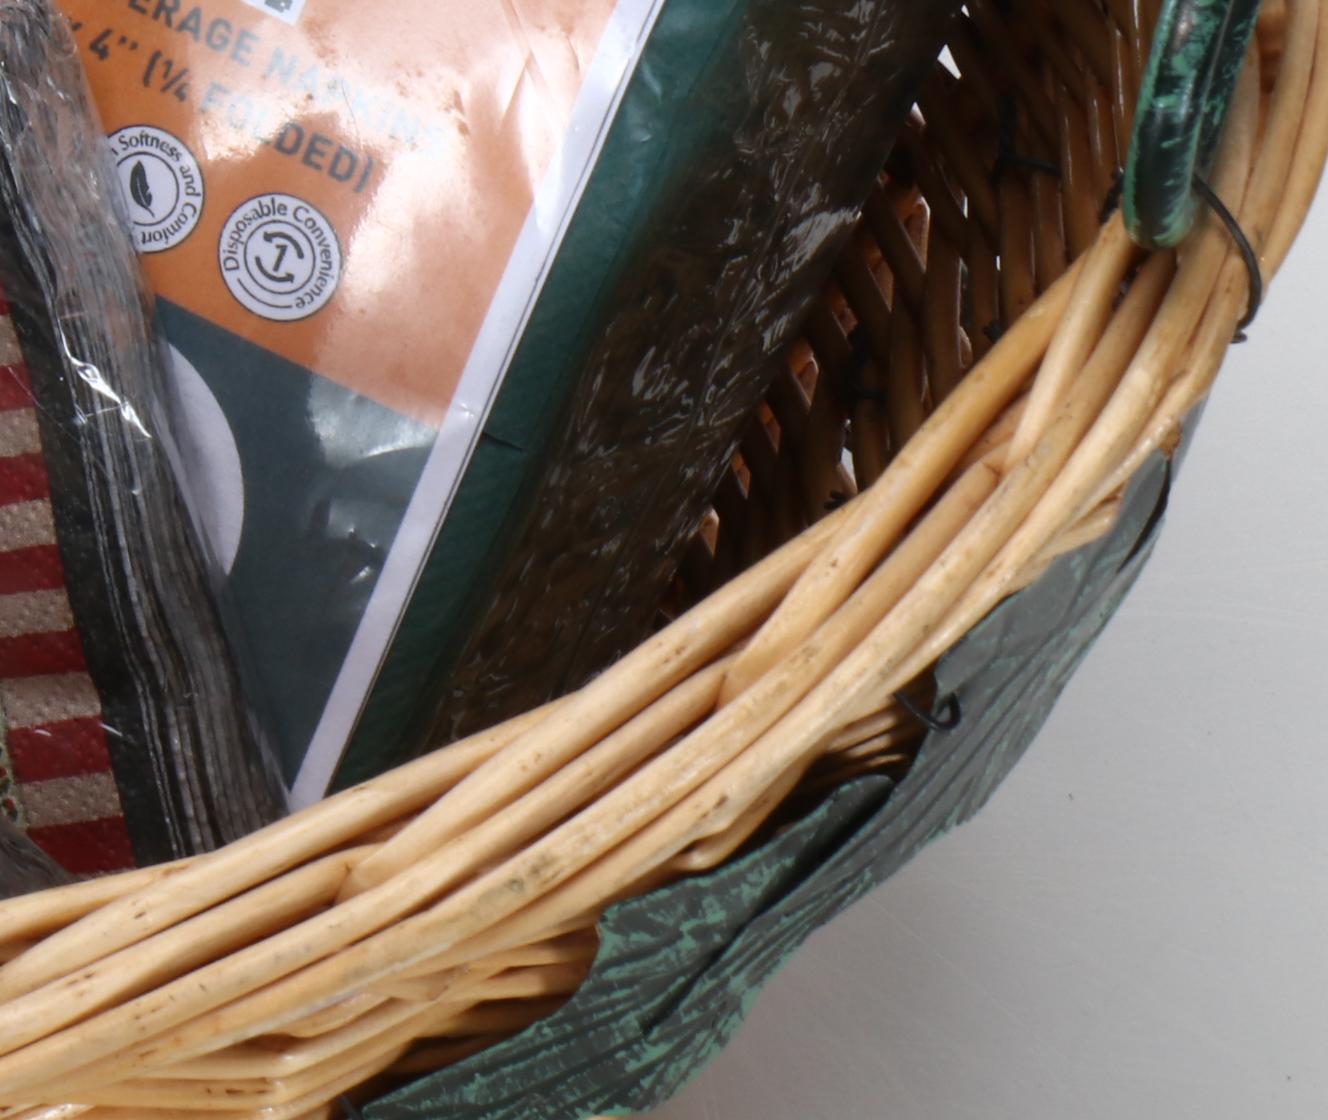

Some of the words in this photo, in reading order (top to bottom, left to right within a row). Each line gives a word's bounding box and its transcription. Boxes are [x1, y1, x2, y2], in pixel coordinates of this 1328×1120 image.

[118, 130, 182, 163] Softness
[178, 164, 202, 198] and
[141, 201, 199, 246] Comfort
[223, 197, 288, 273] Disposable
[293, 204, 335, 310] Convenience
